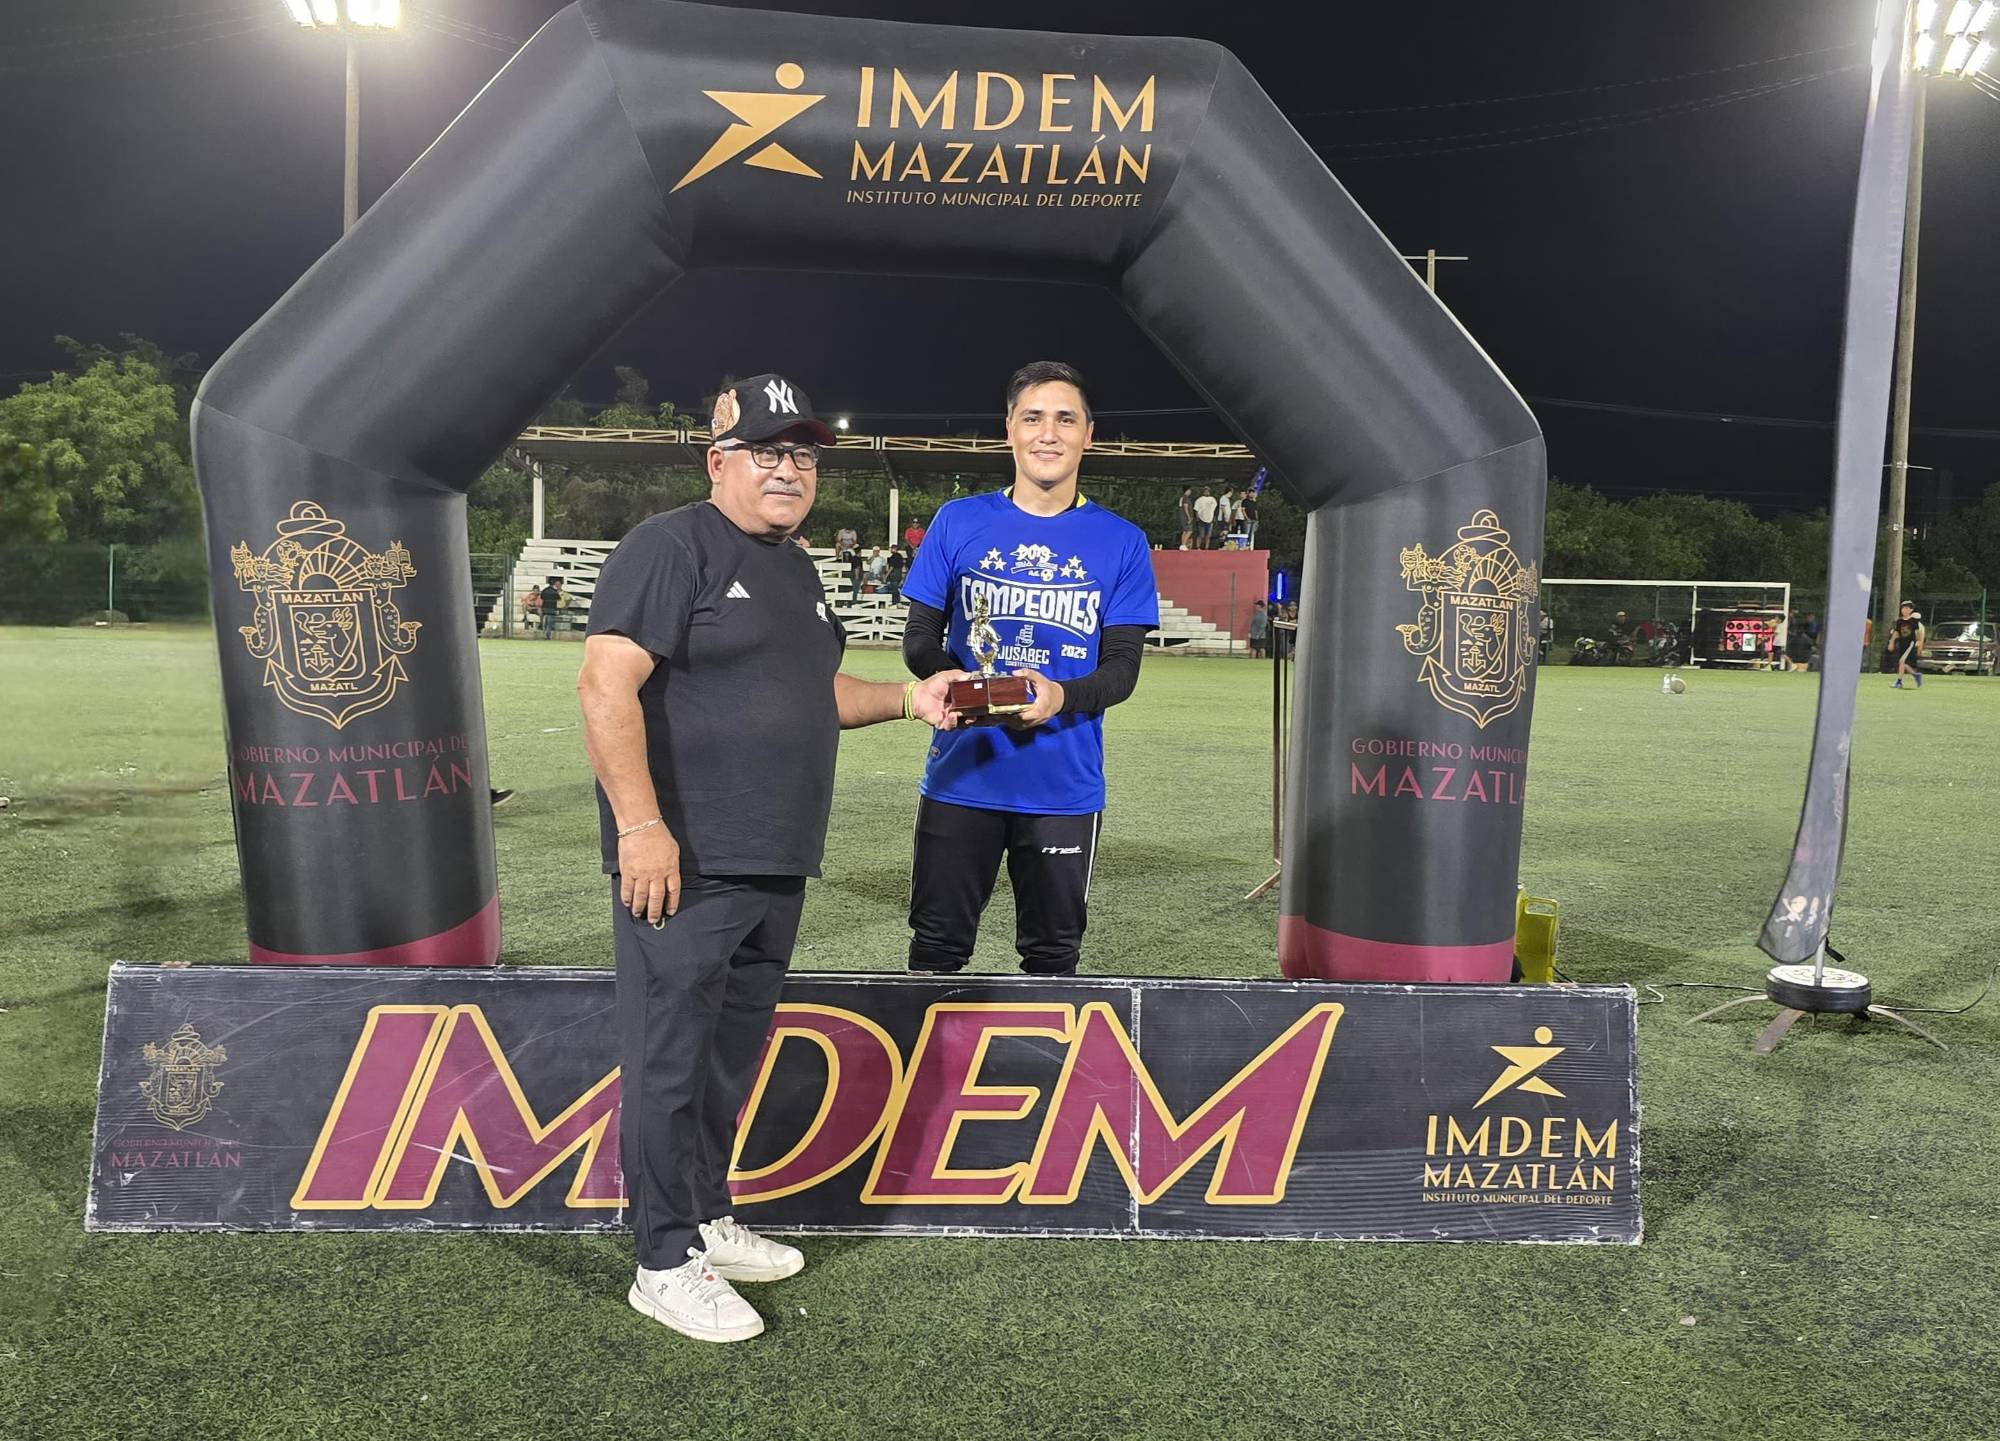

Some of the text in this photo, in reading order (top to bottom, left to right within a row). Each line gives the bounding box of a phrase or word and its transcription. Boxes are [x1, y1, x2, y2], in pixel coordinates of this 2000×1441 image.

[857, 66, 1156, 133] IMDEM
[850, 133, 1152, 185] MAZATLÁN
[846, 190, 1143, 208] INSTITUTO MUNICIPAL DEL DEPORTE
[763, 379, 800, 415] NY
[281, 591, 364, 604] MAZATLAN
[1450, 595, 1514, 611] MAZATLAN
[997, 645, 1050, 666] JUSABEC
[1061, 644, 1088, 660] 2025
[310, 682, 359, 692] MAZATL
[1464, 682, 1500, 694] MAZATL
[240, 745, 321, 765] OBIERNO
[328, 738, 447, 763] MUNICIPAL
[1352, 737, 1463, 760] GOBIERNO
[235, 754, 473, 808] MAZATLÁN
[290, 1002, 1345, 1210] IMDEM
[1425, 1114, 1619, 1160] IMDEM
[1423, 1159, 1616, 1191] MAZATLÁN
[1422, 1192, 1613, 1206] INSTITUTO MUNICIPAL DEL DEPORTE
